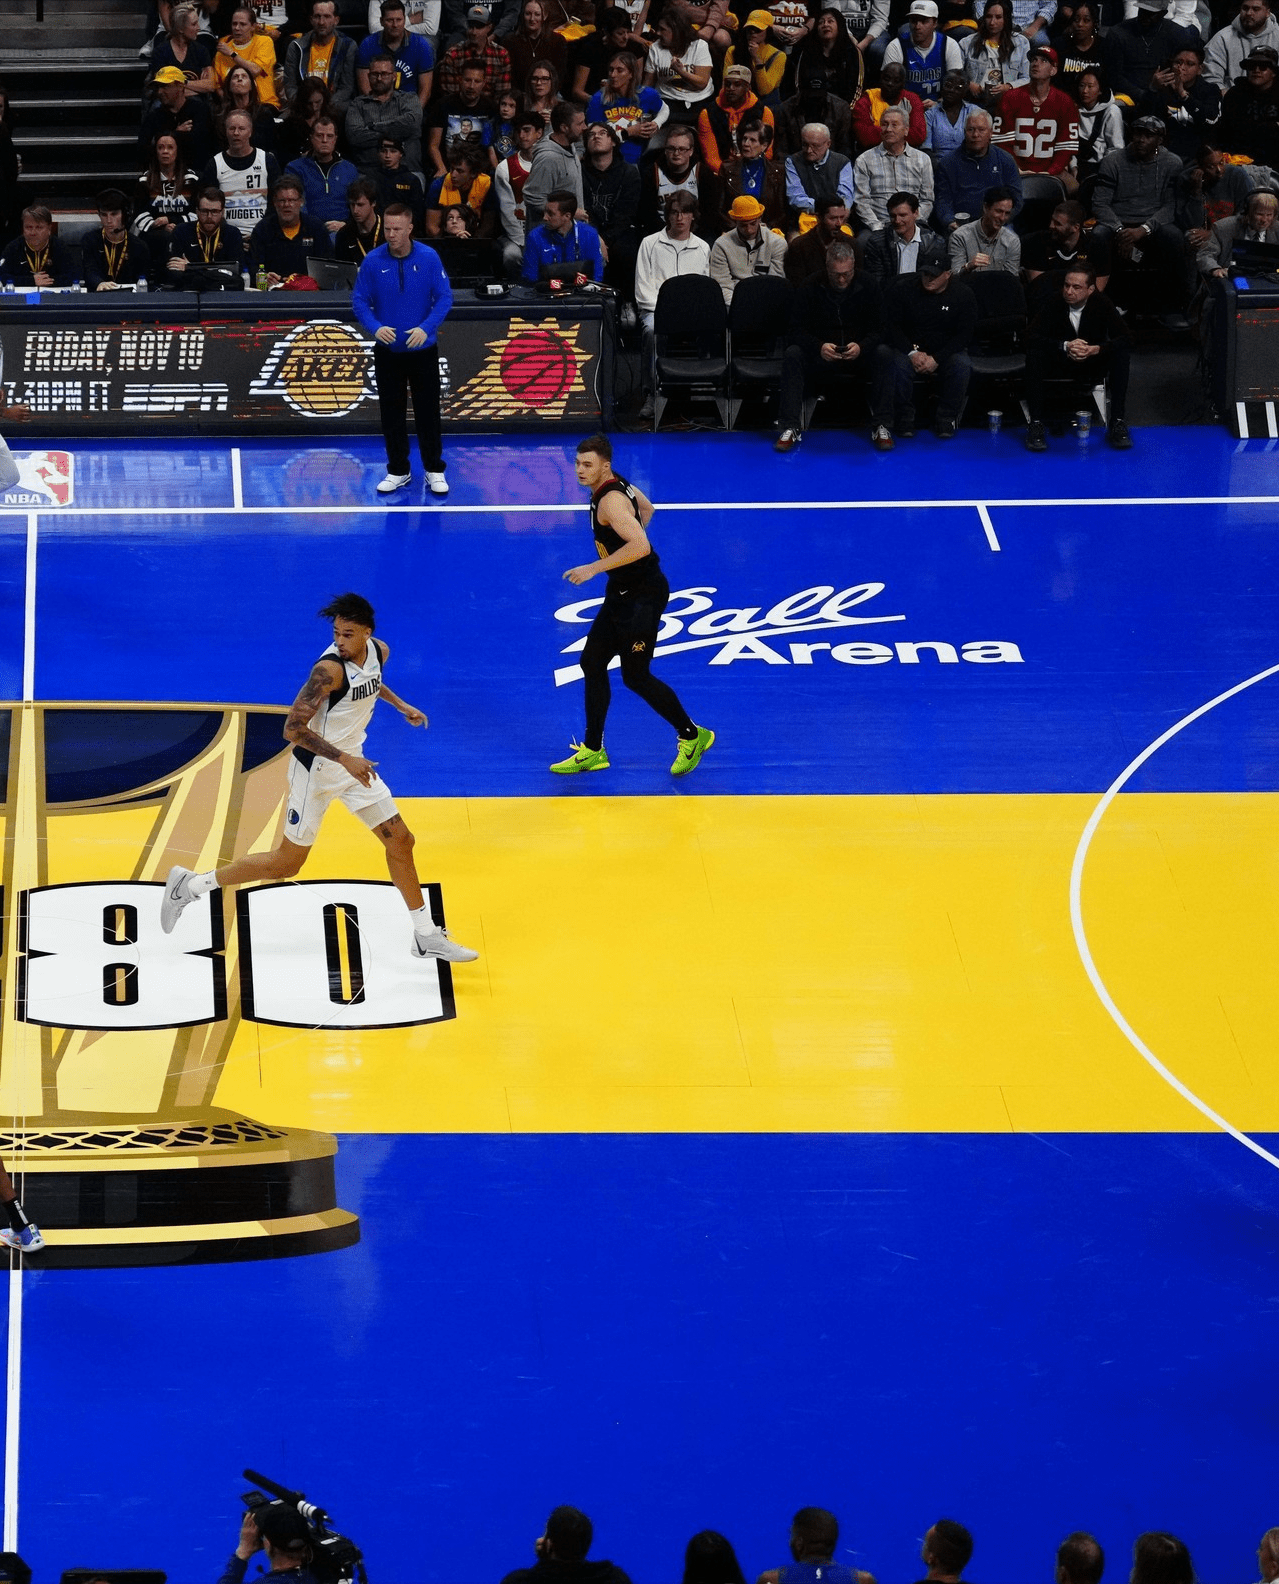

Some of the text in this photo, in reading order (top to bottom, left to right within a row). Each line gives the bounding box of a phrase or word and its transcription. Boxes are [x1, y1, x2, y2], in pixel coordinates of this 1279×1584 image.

[774, 16, 805, 25] ENVER
[395, 59, 414, 78] HIGH
[658, 64, 695, 77] NUGTS
[604, 106, 643, 119] DENVER
[1013, 118, 1057, 158] 52
[246, 174, 261, 189] 27
[225, 208, 265, 220] NUGGETS
[24, 330, 112, 376] FRIDAY,
[119, 330, 173, 371] NOV
[178, 329, 205, 371] 10
[89, 381, 112, 412] ET
[122, 383, 229, 412] ESPN
[4, 493, 43, 504] NBA
[708, 637, 1026, 665] Arena
